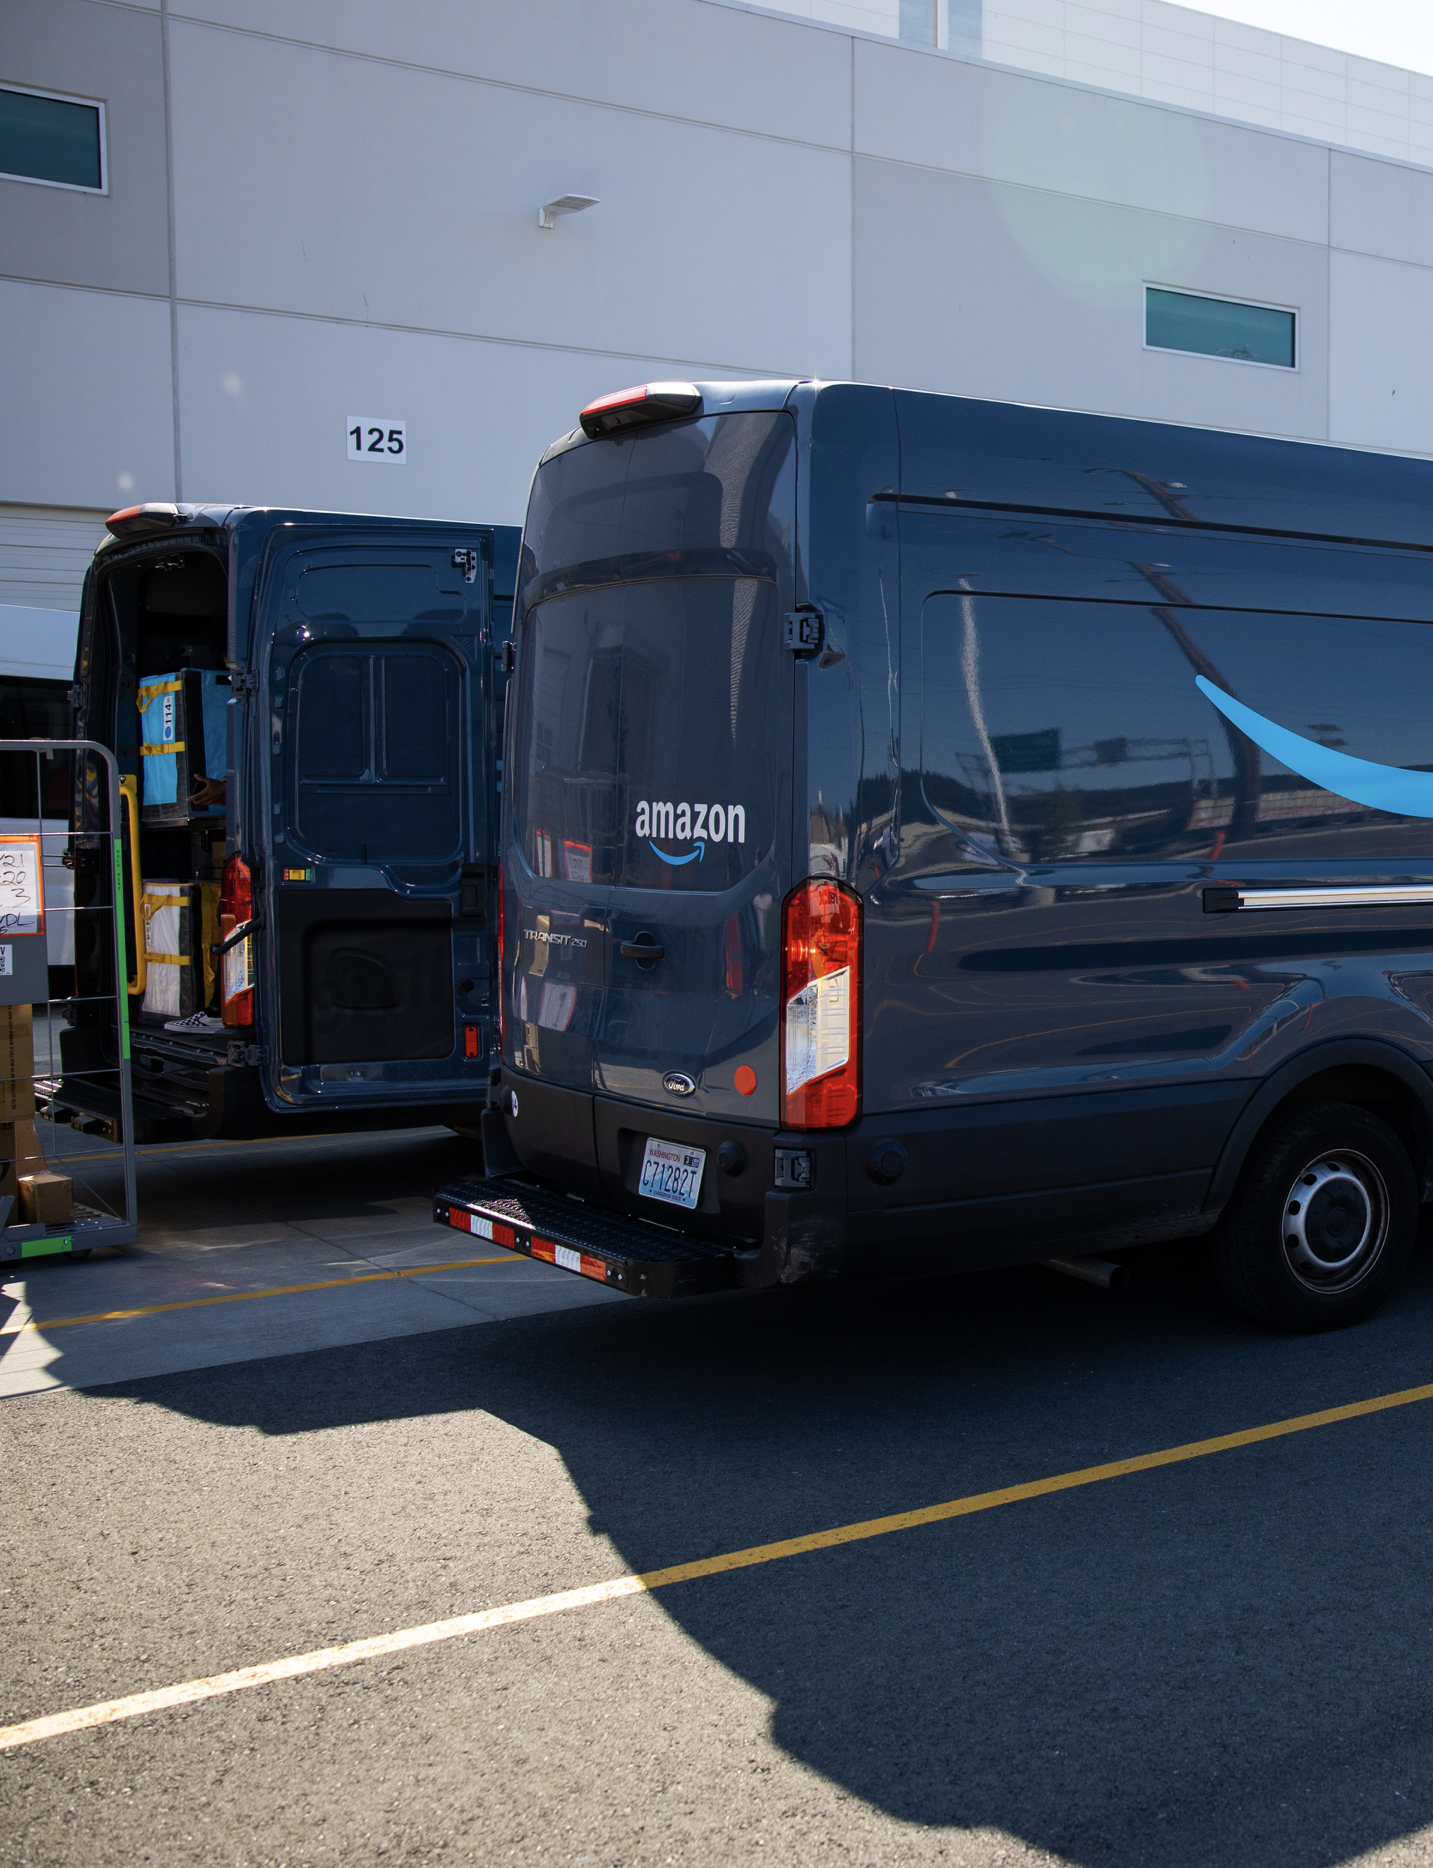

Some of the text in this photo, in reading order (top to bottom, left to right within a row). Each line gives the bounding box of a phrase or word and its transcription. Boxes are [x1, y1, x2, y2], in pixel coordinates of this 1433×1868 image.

[349, 425, 404, 455] 125
[635, 800, 746, 843] amazon
[0, 853, 25, 868] 21
[0, 871, 27, 886] 20
[524, 929, 588, 948] TRANSIT 250
[668, 1082, 686, 1092] Ford
[649, 1148, 681, 1163] WASHINGTON
[642, 1160, 697, 1198] C71282T
